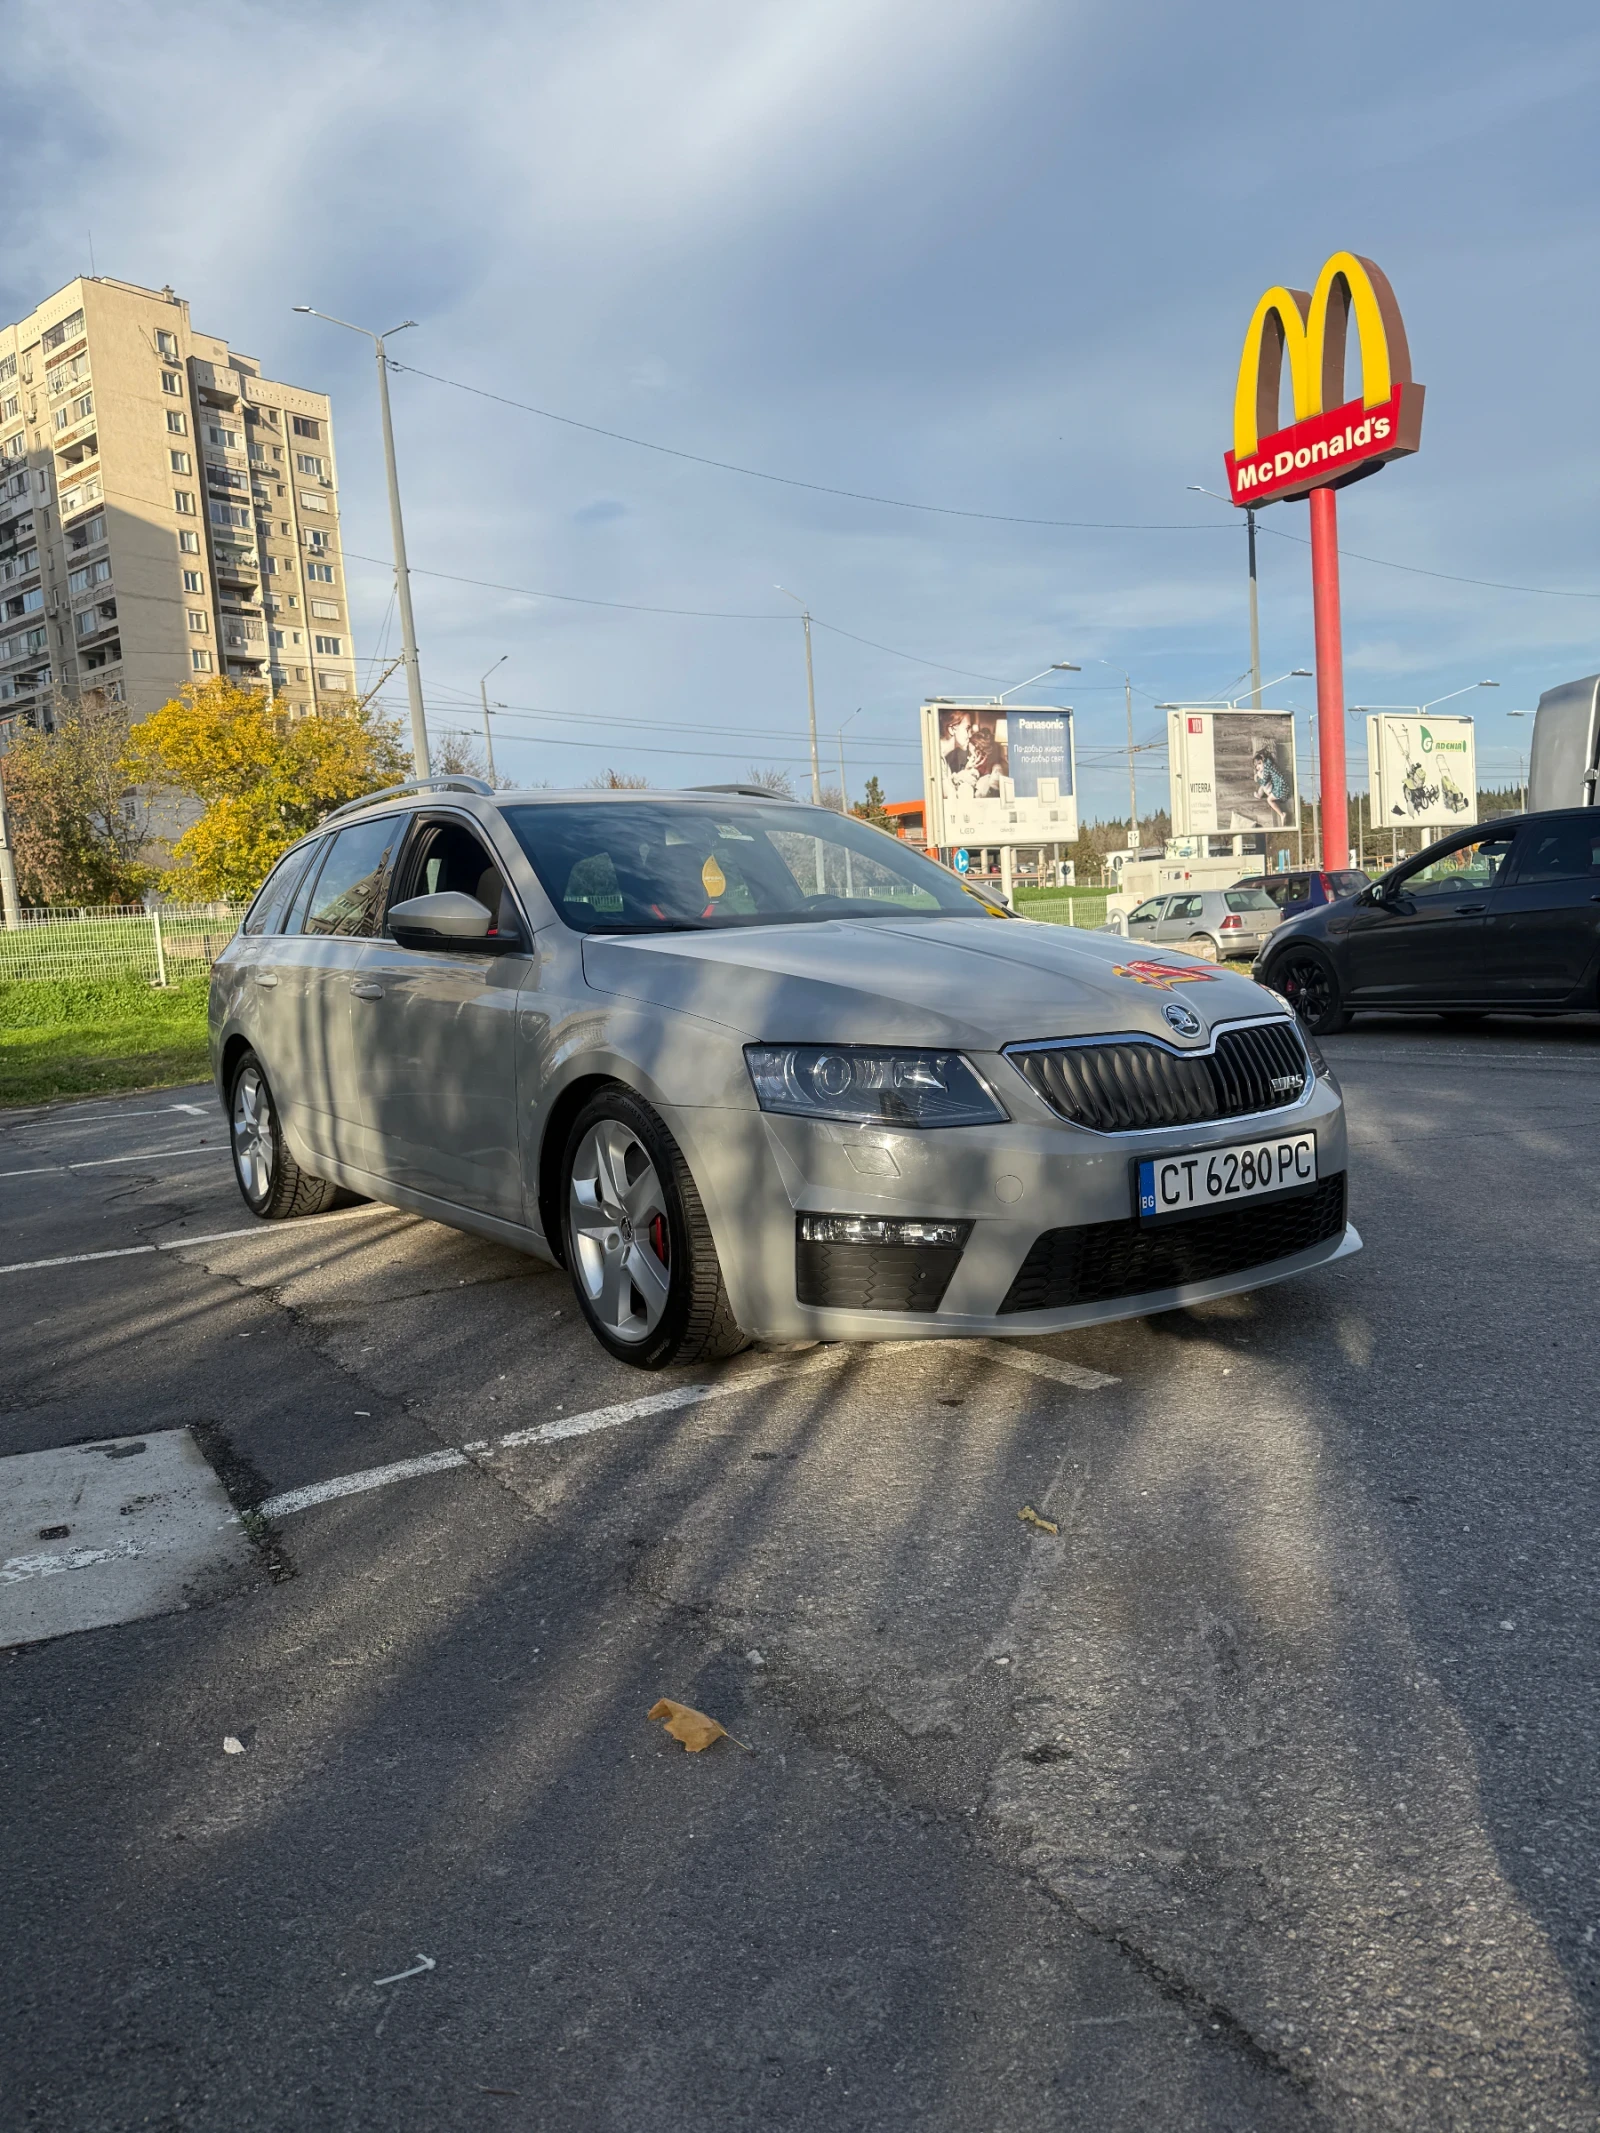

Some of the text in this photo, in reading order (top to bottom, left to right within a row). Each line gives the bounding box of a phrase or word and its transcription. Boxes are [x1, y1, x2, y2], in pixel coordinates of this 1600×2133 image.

[1236, 416, 1391, 492] McDonald's
[1019, 718, 1064, 729] Panasonic
[1013, 744, 1043, 754] По-добър
[1021, 754, 1050, 764] по-добър
[1189, 782, 1212, 793] VITERRA
[1161, 1141, 1311, 1205] CT 6280 PC
[1142, 1195, 1154, 1209] BG
